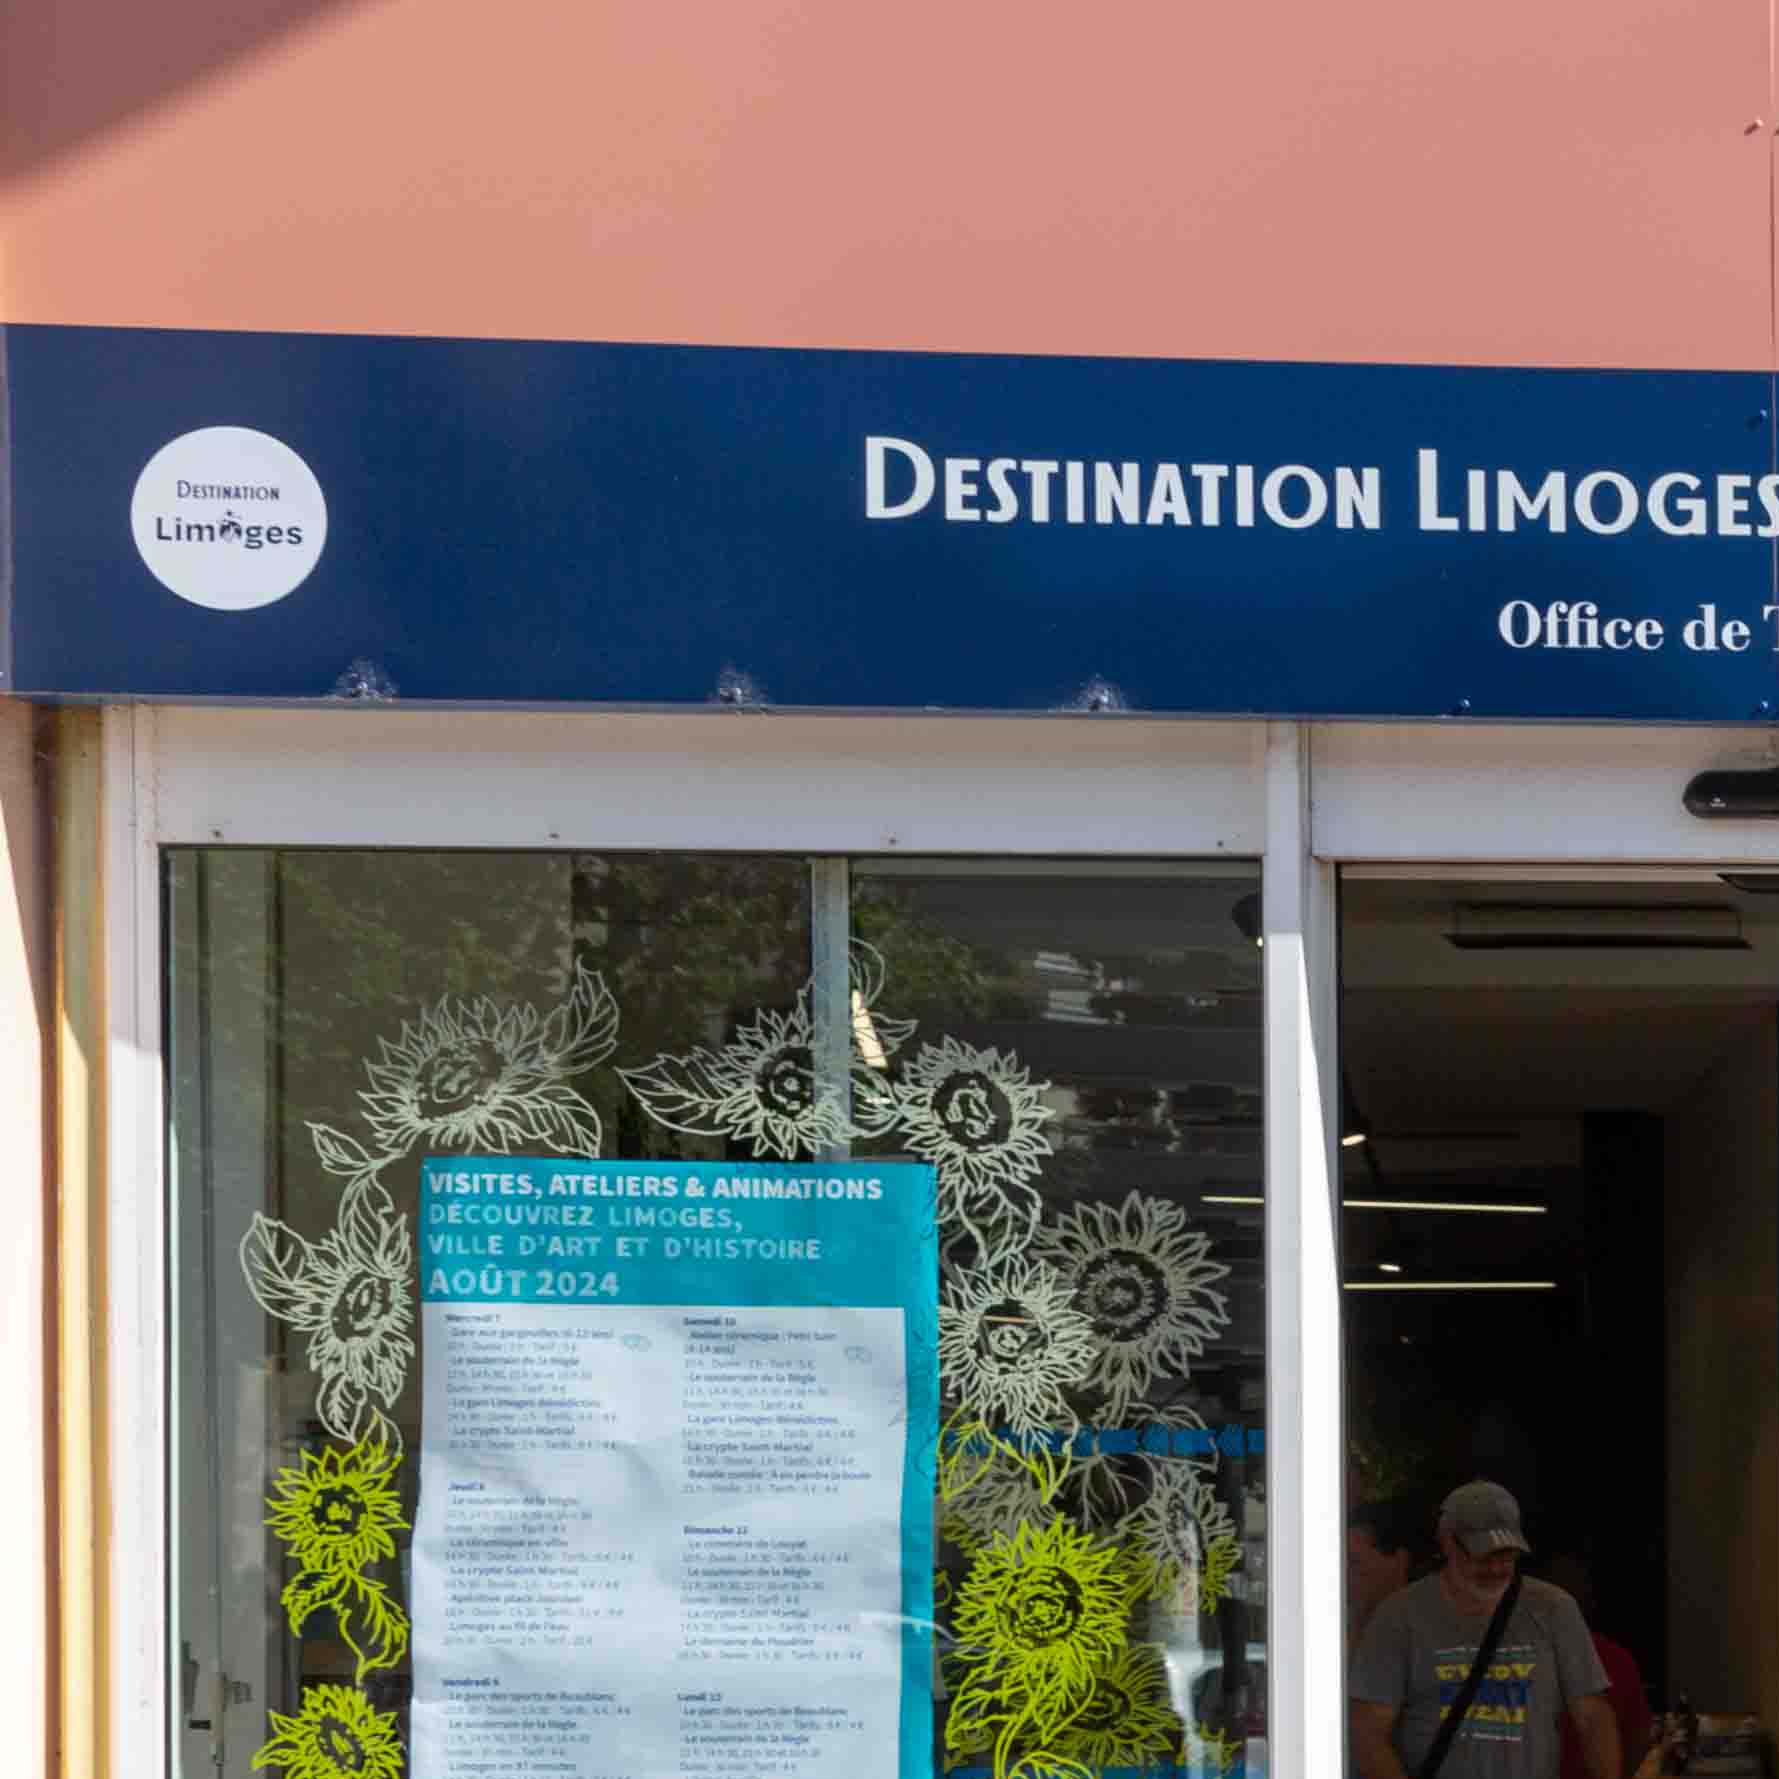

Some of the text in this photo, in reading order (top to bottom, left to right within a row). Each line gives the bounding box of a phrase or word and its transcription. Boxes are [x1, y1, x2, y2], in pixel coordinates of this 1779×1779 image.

[176, 479, 281, 502] DESTINATION
[865, 436, 1382, 530] DESTINATION
[155, 512, 304, 550] Limoges
[1497, 600, 1665, 652] Office
[1682, 602, 1752, 653] de
[429, 1173, 883, 1200] VISITES, ATELIERS & ANIMATIONS
[430, 1203, 744, 1232] DÉCOUVREZ LIMOGES,
[429, 1235, 822, 1260] VILLE D'ART ET D'HISTOIRE
[428, 1267, 620, 1297] AOÛT 2024
